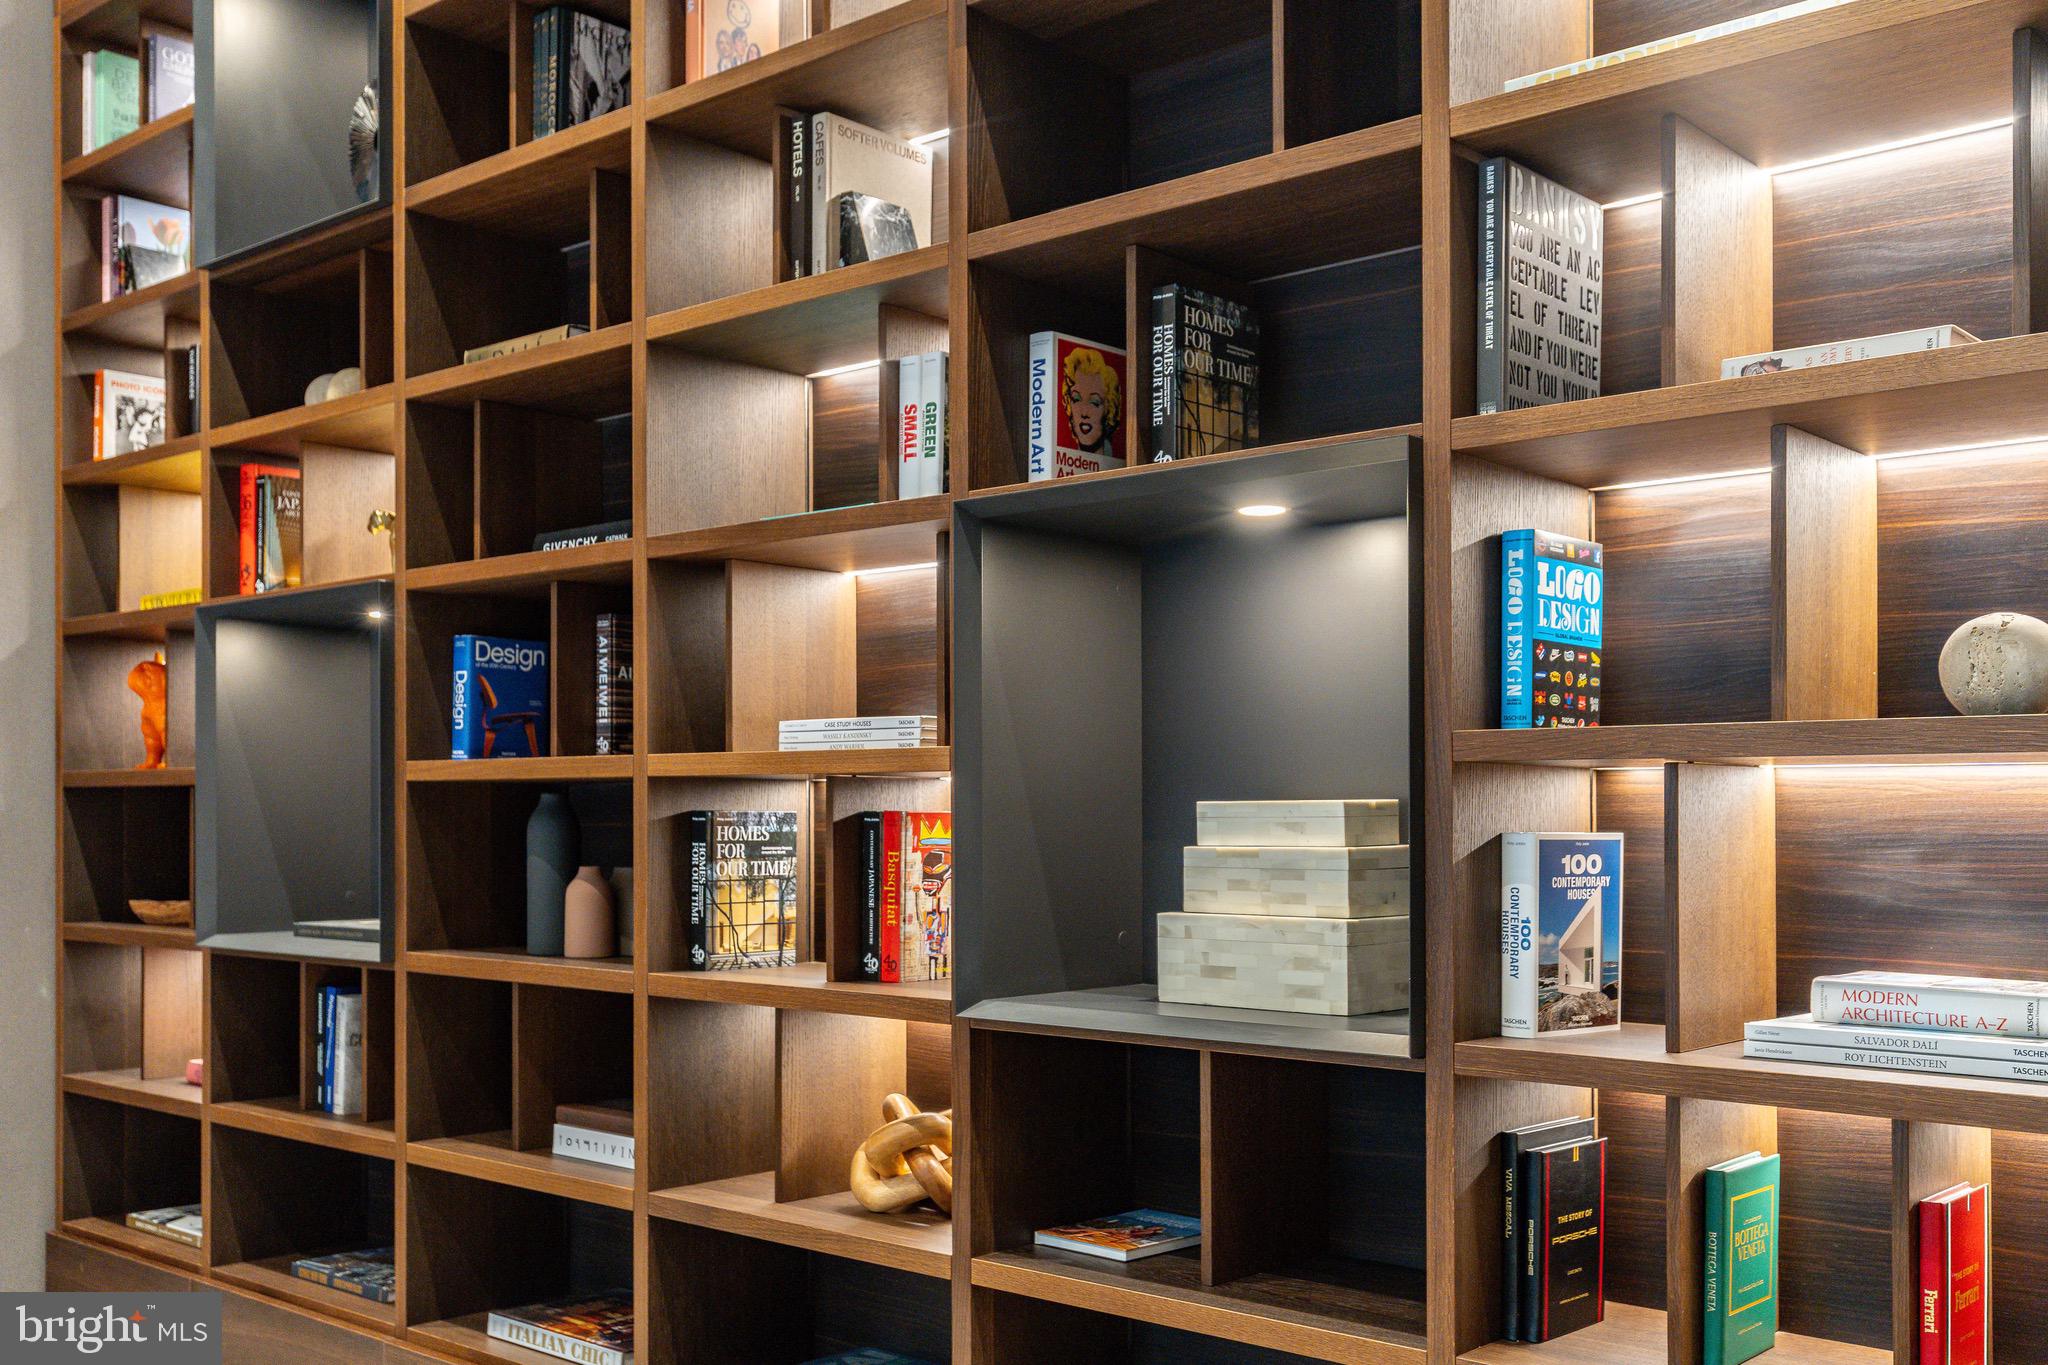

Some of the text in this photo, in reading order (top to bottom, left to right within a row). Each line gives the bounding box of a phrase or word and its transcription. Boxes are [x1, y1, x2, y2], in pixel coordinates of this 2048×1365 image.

[792, 120, 803, 178] HOTELS
[815, 121, 825, 167] CAFES
[838, 124, 927, 165] SOFTER VOLUMES
[1486, 165, 1495, 194] BANKSY
[1486, 198, 1495, 213] YOU
[1486, 214, 1495, 229] ARE
[1509, 166, 1601, 251] BANKSY
[1486, 230, 1495, 240] AN
[1510, 220, 1601, 283] YOU ARE AN AC
[1485, 241, 1495, 287] ACCEPTABLE
[1510, 256, 1568, 303] CEPTABLE
[1184, 305, 1234, 337] HOMES
[1485, 311, 1494, 319] OF
[1510, 289, 1599, 348] EL OF THREAT
[1164, 323, 1174, 375] HOMES
[1184, 327, 1212, 353] FOR
[1485, 321, 1494, 350] THREAT
[1184, 349, 1253, 385] OUR TIME
[1510, 325, 1598, 381] AND IF YOU WERE
[1153, 326, 1164, 426] FOR OUR TIME
[1509, 360, 1531, 391] NOT
[1536, 369, 1558, 399] YOU
[924, 401, 937, 458] GREEN
[1032, 358, 1046, 474] Modern Art
[903, 403, 918, 463] SMALL
[1056, 451, 1100, 473] Modern
[543, 535, 598, 551] GIVENCHY
[1508, 549, 1524, 615] LOGO
[1537, 561, 1601, 605] LOGO
[1537, 598, 1600, 636] DESIGN
[475, 640, 545, 672] Design
[618, 665, 633, 679] AI
[1506, 621, 1523, 697] DESIGN
[598, 635, 609, 723] AI WEIWEI
[452, 670, 468, 730] Design
[716, 825, 770, 842] HOMES
[716, 843, 746, 859] FOR
[1561, 853, 1603, 875] 100
[691, 842, 699, 925] FOR OUR TIME
[716, 860, 789, 877] OUR TIME
[1552, 876, 1611, 888] CONTEMPORARY
[883, 851, 900, 927] Basquiat
[1567, 888, 1595, 900] HOUSES
[1510, 887, 1520, 979] CONTEMPORARY
[1520, 917, 1532, 951] 100
[1841, 988, 1919, 1007] MODERN
[1504, 1017, 1527, 1025] TASCHEN
[1841, 1007, 1969, 1029] ARCHITECTURE
[1854, 1035, 1910, 1049] SALVADOR
[1912, 1038, 1938, 1050] DALÍ
[2013, 1048, 2048, 1058] TASCHEN
[1844, 1052, 1866, 1062] ROY
[1869, 1054, 1948, 1069] LICHTENSTEIN
[2012, 1066, 2048, 1077] TASCHEN
[1505, 1168, 1513, 1193] VIVA
[1557, 1208, 1593, 1225] THE STORY OF
[1551, 1226, 1598, 1246] PORSCHE
[1735, 1222, 1769, 1247] BOTTEGA
[1738, 1239, 1766, 1261] VENETA
[1707, 1231, 1717, 1313] BOTTEGA VENETA
[1923, 1288, 1939, 1334] Ferrari
[1954, 1280, 1980, 1313] Ferrari
[507, 1323, 609, 1365] ITALIAN CHIC
